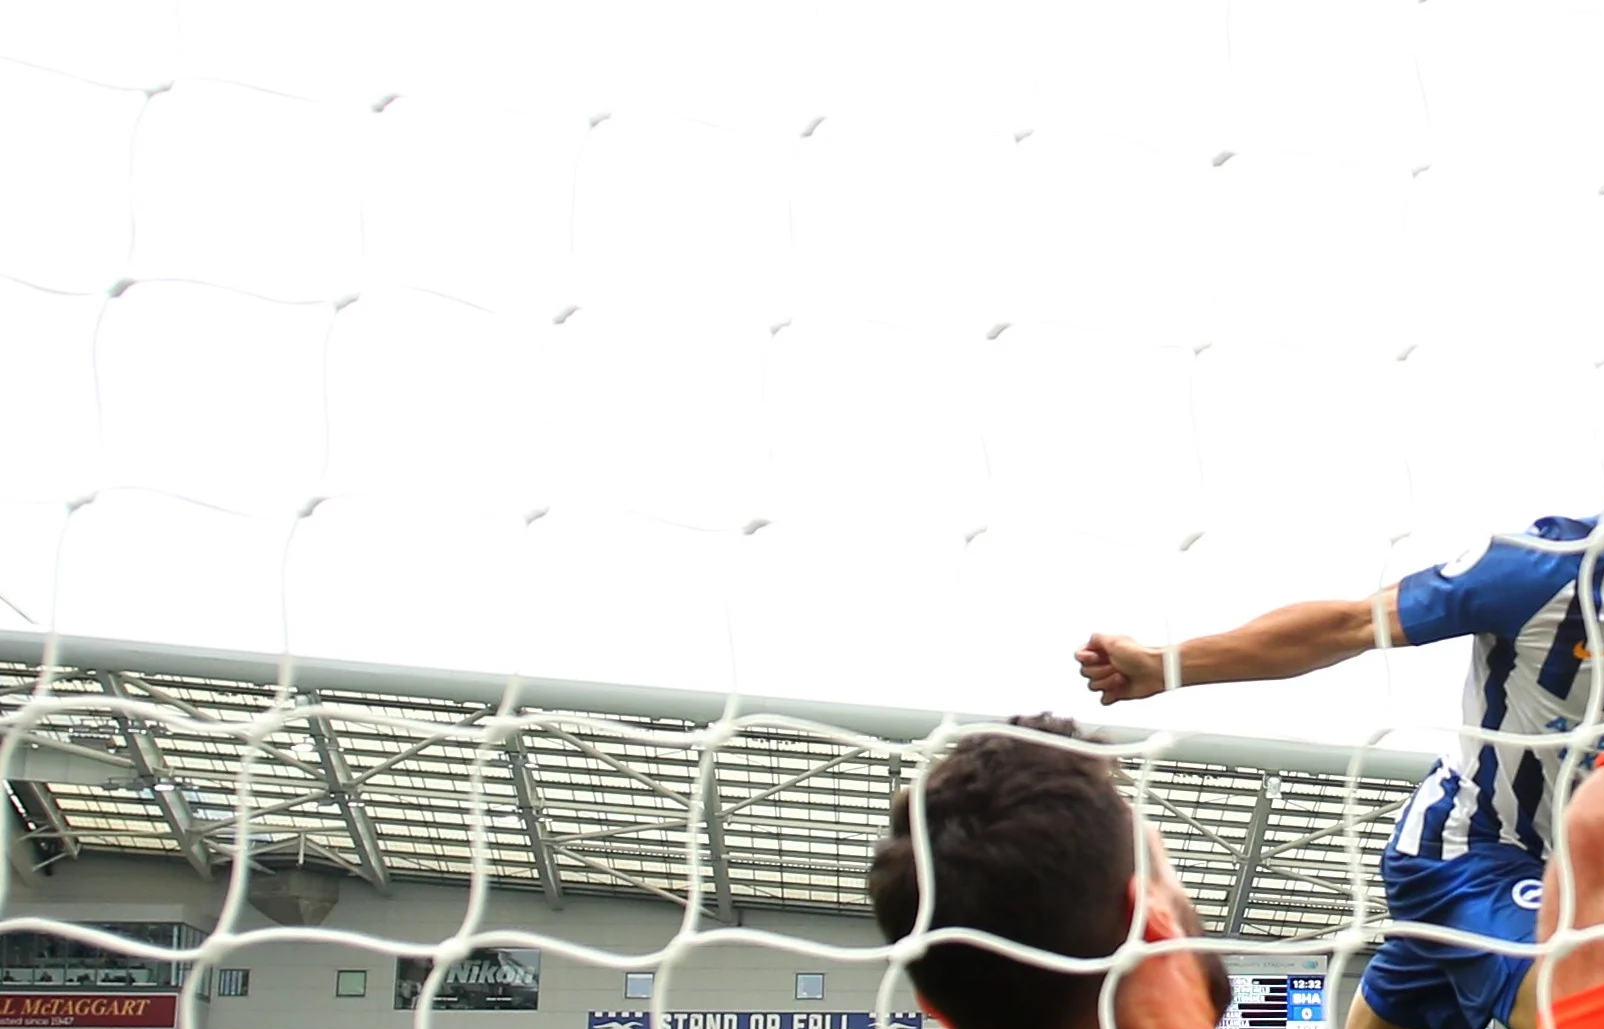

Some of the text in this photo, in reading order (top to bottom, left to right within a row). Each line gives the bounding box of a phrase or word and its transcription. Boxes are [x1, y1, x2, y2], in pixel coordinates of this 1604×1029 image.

[1293, 979, 1322, 990] 12:32
[21, 998, 151, 1016] McTAGGART
[1301, 1008, 1312, 1020] 0
